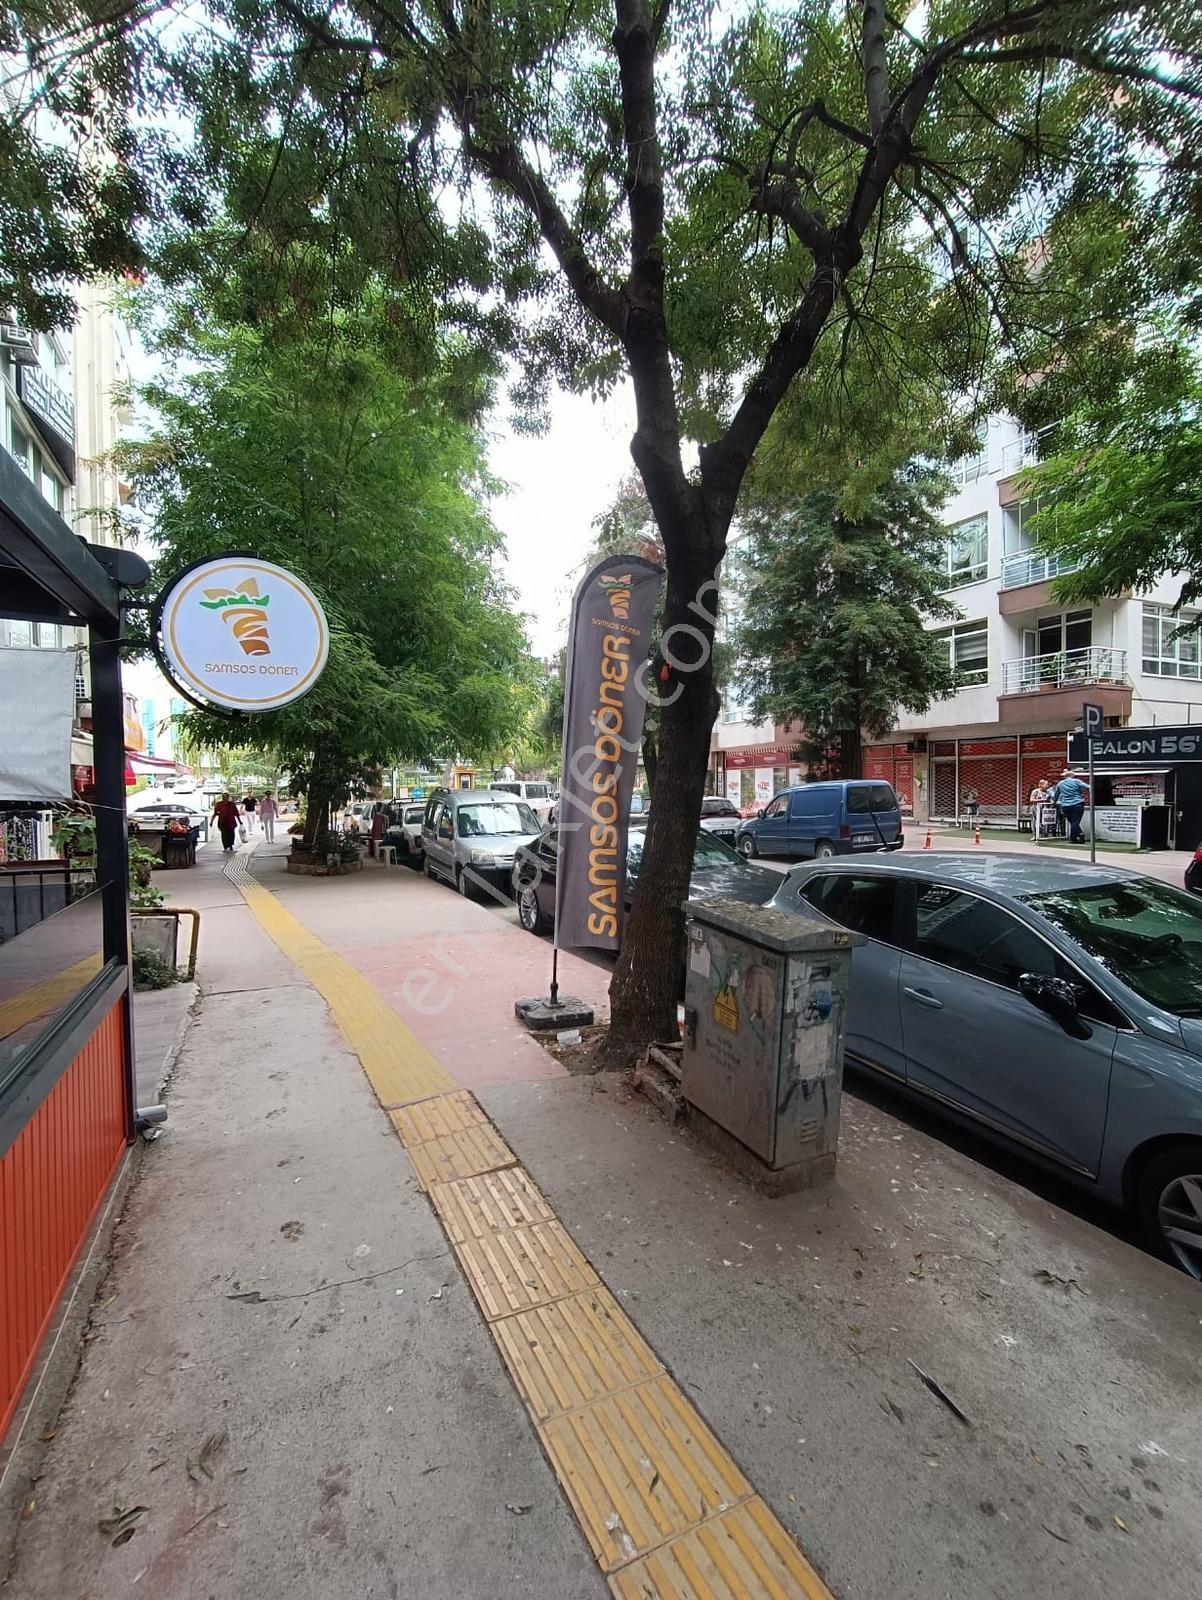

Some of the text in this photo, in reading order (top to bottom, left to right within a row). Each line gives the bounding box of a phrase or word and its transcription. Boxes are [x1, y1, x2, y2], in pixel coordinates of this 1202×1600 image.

[204, 663, 256, 674] SAMSOS
[1086, 705, 1100, 736] P
[1092, 739, 1156, 755] SALON
[588, 772, 618, 938] SAMSOS
